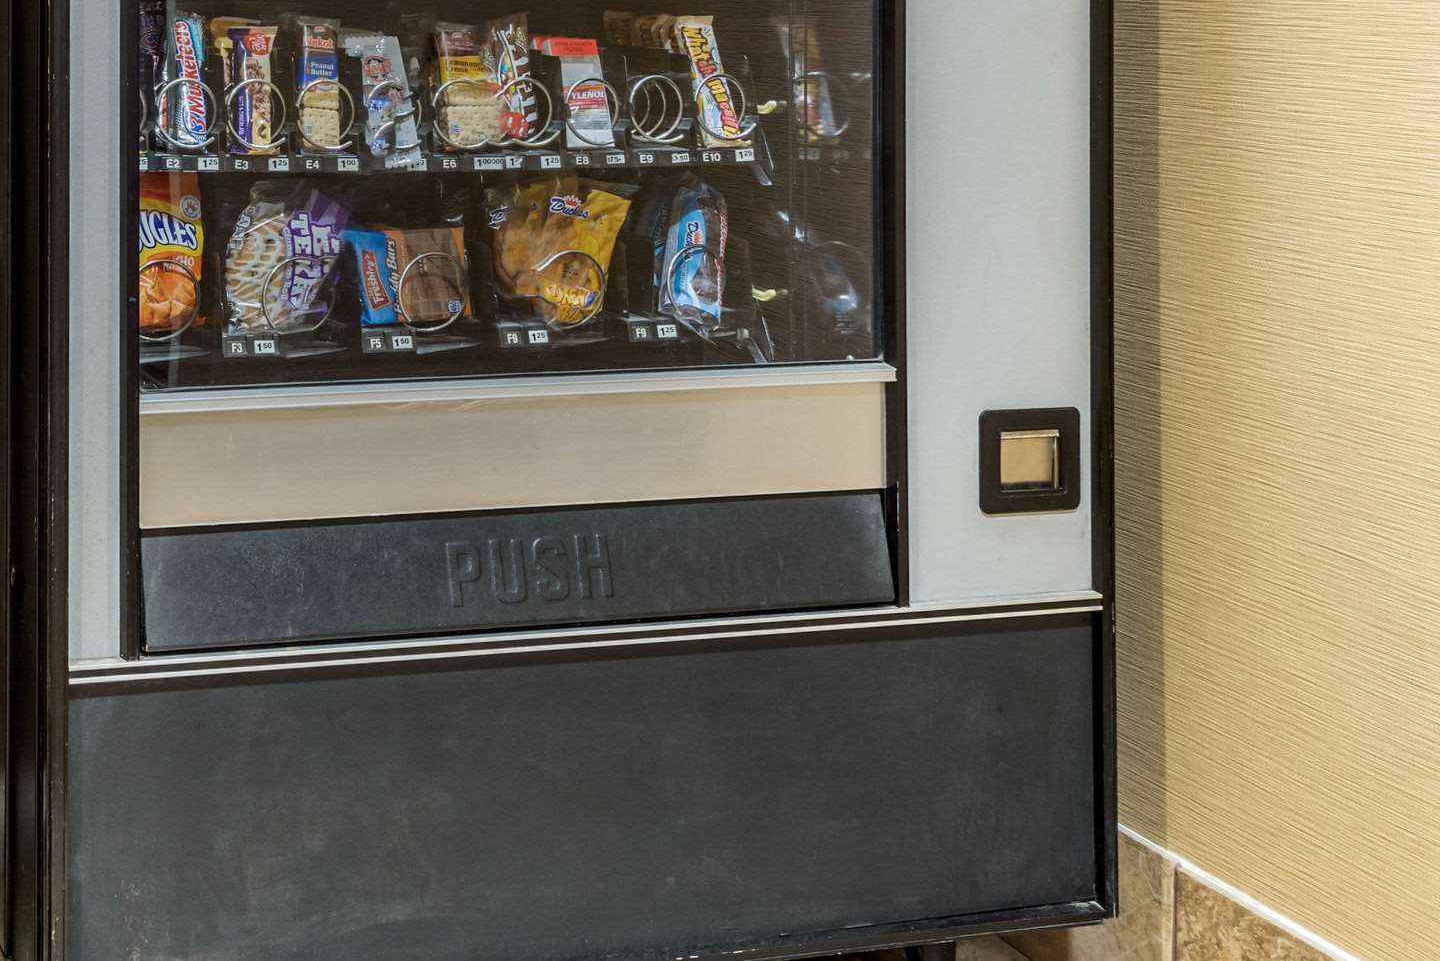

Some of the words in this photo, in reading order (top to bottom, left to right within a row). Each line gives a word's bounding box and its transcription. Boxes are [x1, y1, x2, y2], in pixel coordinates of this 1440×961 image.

[576, 156, 590, 165] E8
[640, 155, 654, 164] E9
[703, 153, 721, 162] E10
[166, 160, 180, 168] E2
[235, 160, 249, 170] E3
[306, 160, 320, 169] E4
[443, 160, 457, 168] E6
[139, 211, 197, 251] UGLES
[386, 238, 399, 270] Bars
[636, 328, 647, 338] F9
[370, 339, 382, 348] F5
[445, 534, 615, 608] PUSH
